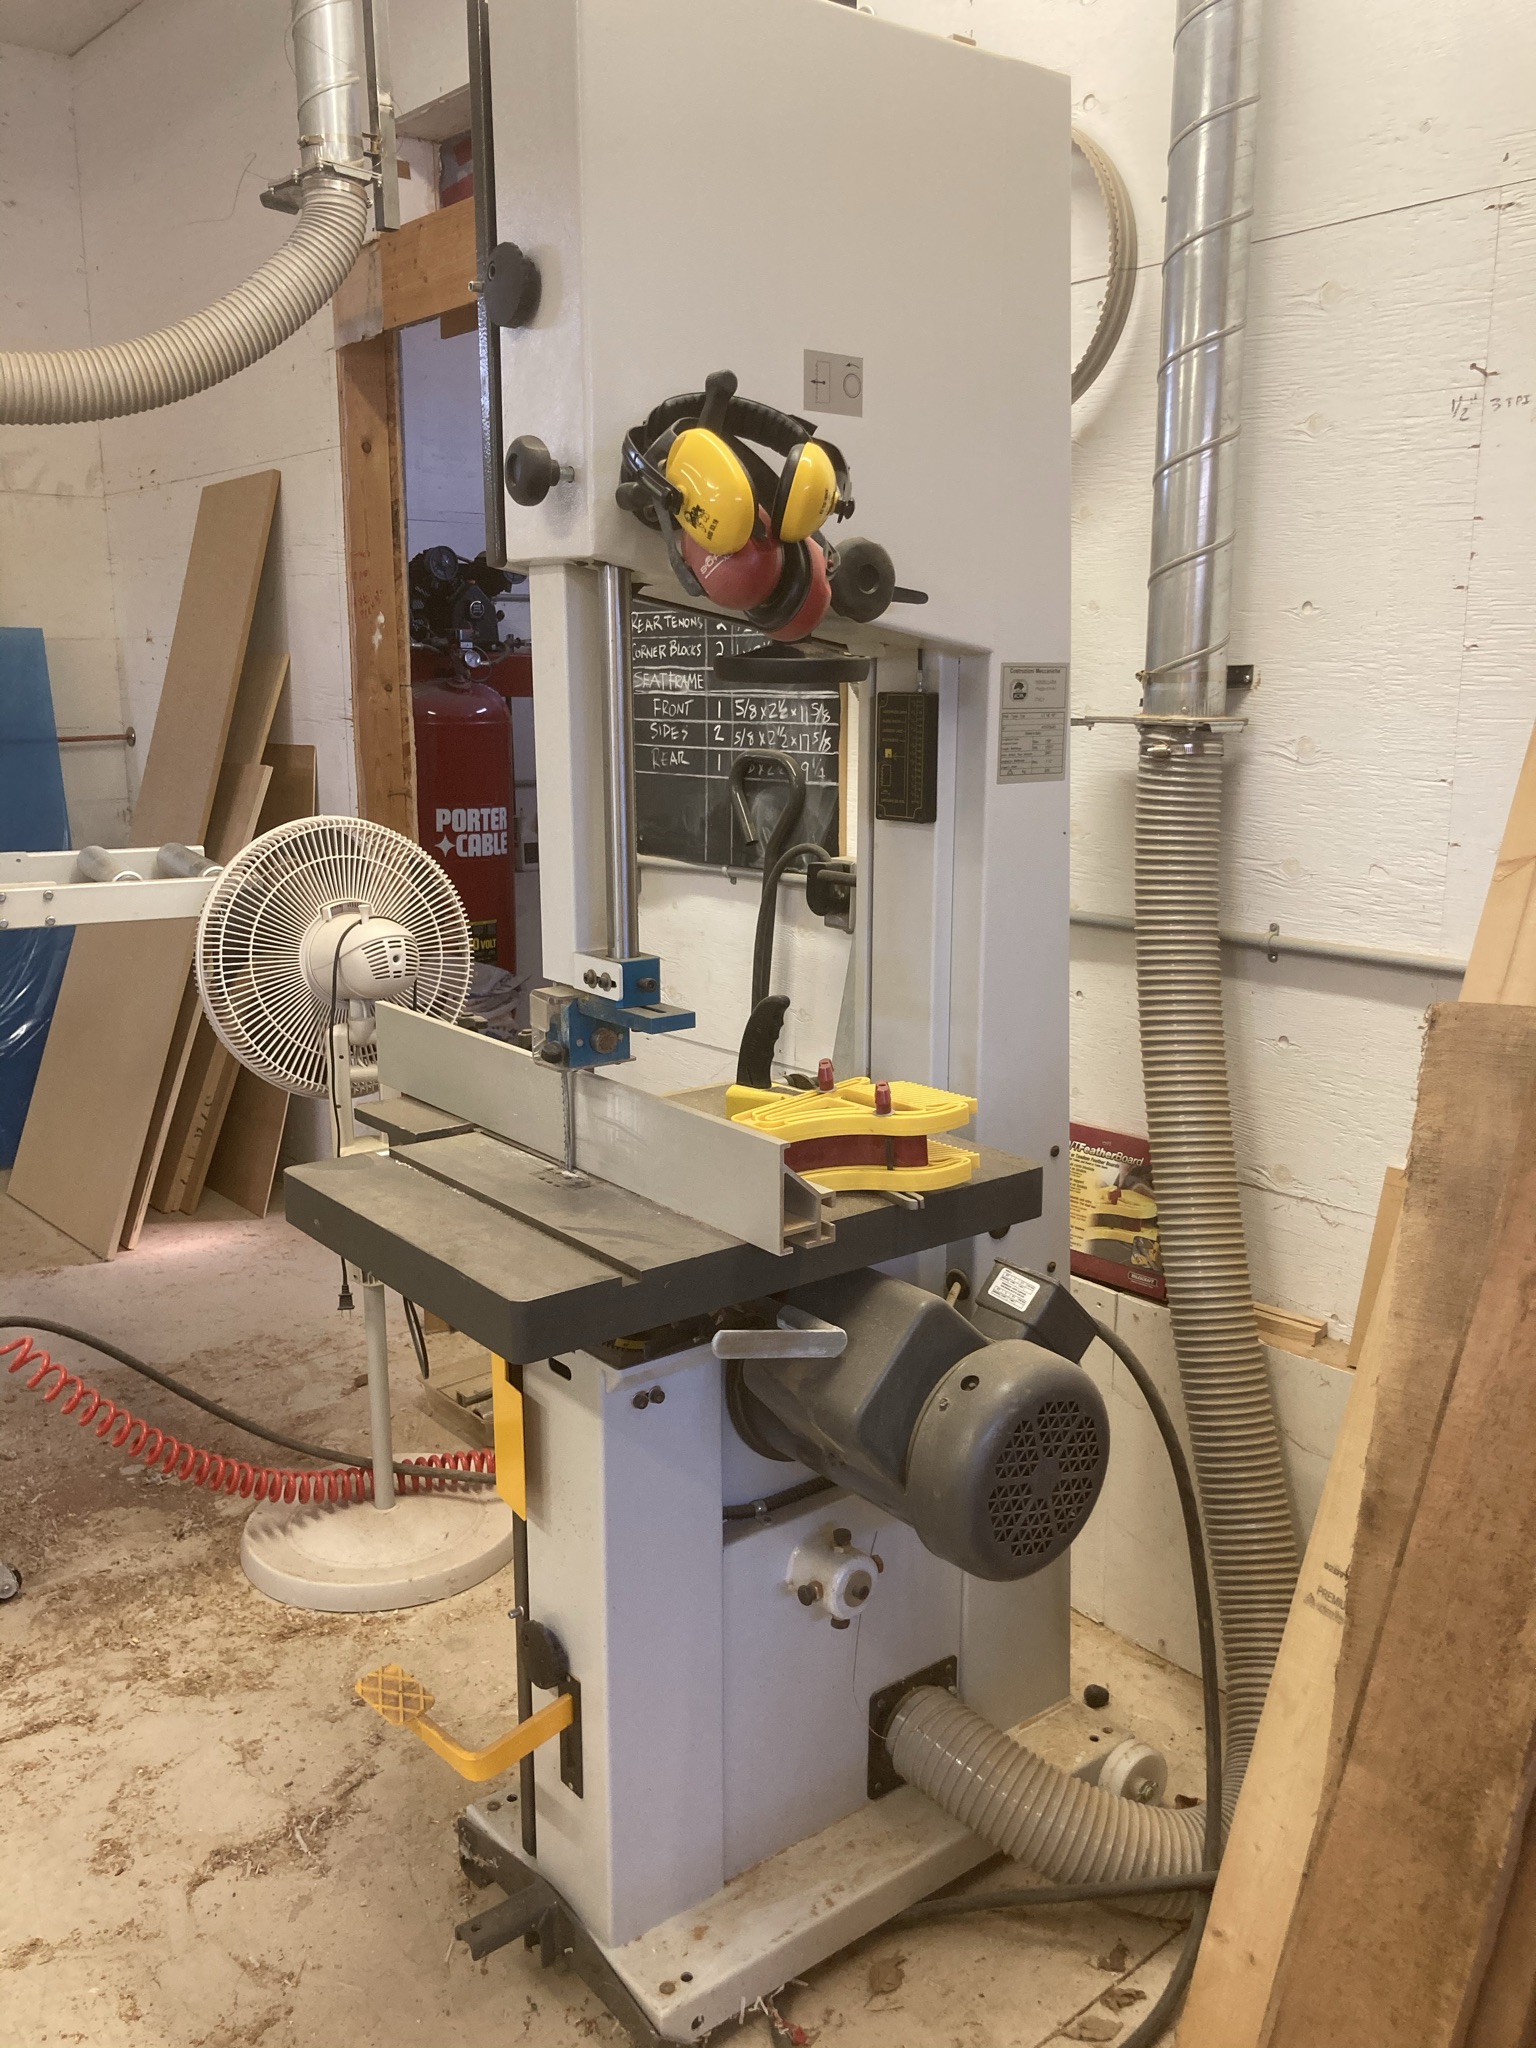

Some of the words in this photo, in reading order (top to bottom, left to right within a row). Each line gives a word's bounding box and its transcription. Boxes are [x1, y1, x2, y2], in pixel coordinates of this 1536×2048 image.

[1490, 398, 1501, 412] 3
[631, 612, 663, 634] REAR
[664, 615, 704, 630] TENONS
[669, 639, 702, 657] BLOCKS
[633, 671, 668, 690] SEAT
[668, 671, 704, 690] FRAME
[653, 698, 694, 717] FRONT
[650, 722, 688, 741] SIDES
[713, 724, 724, 741] 2
[652, 747, 690, 770] REAR
[436, 807, 507, 833] PORTER
[456, 832, 508, 858] CABLE
[480, 938, 497, 949] VOLT
